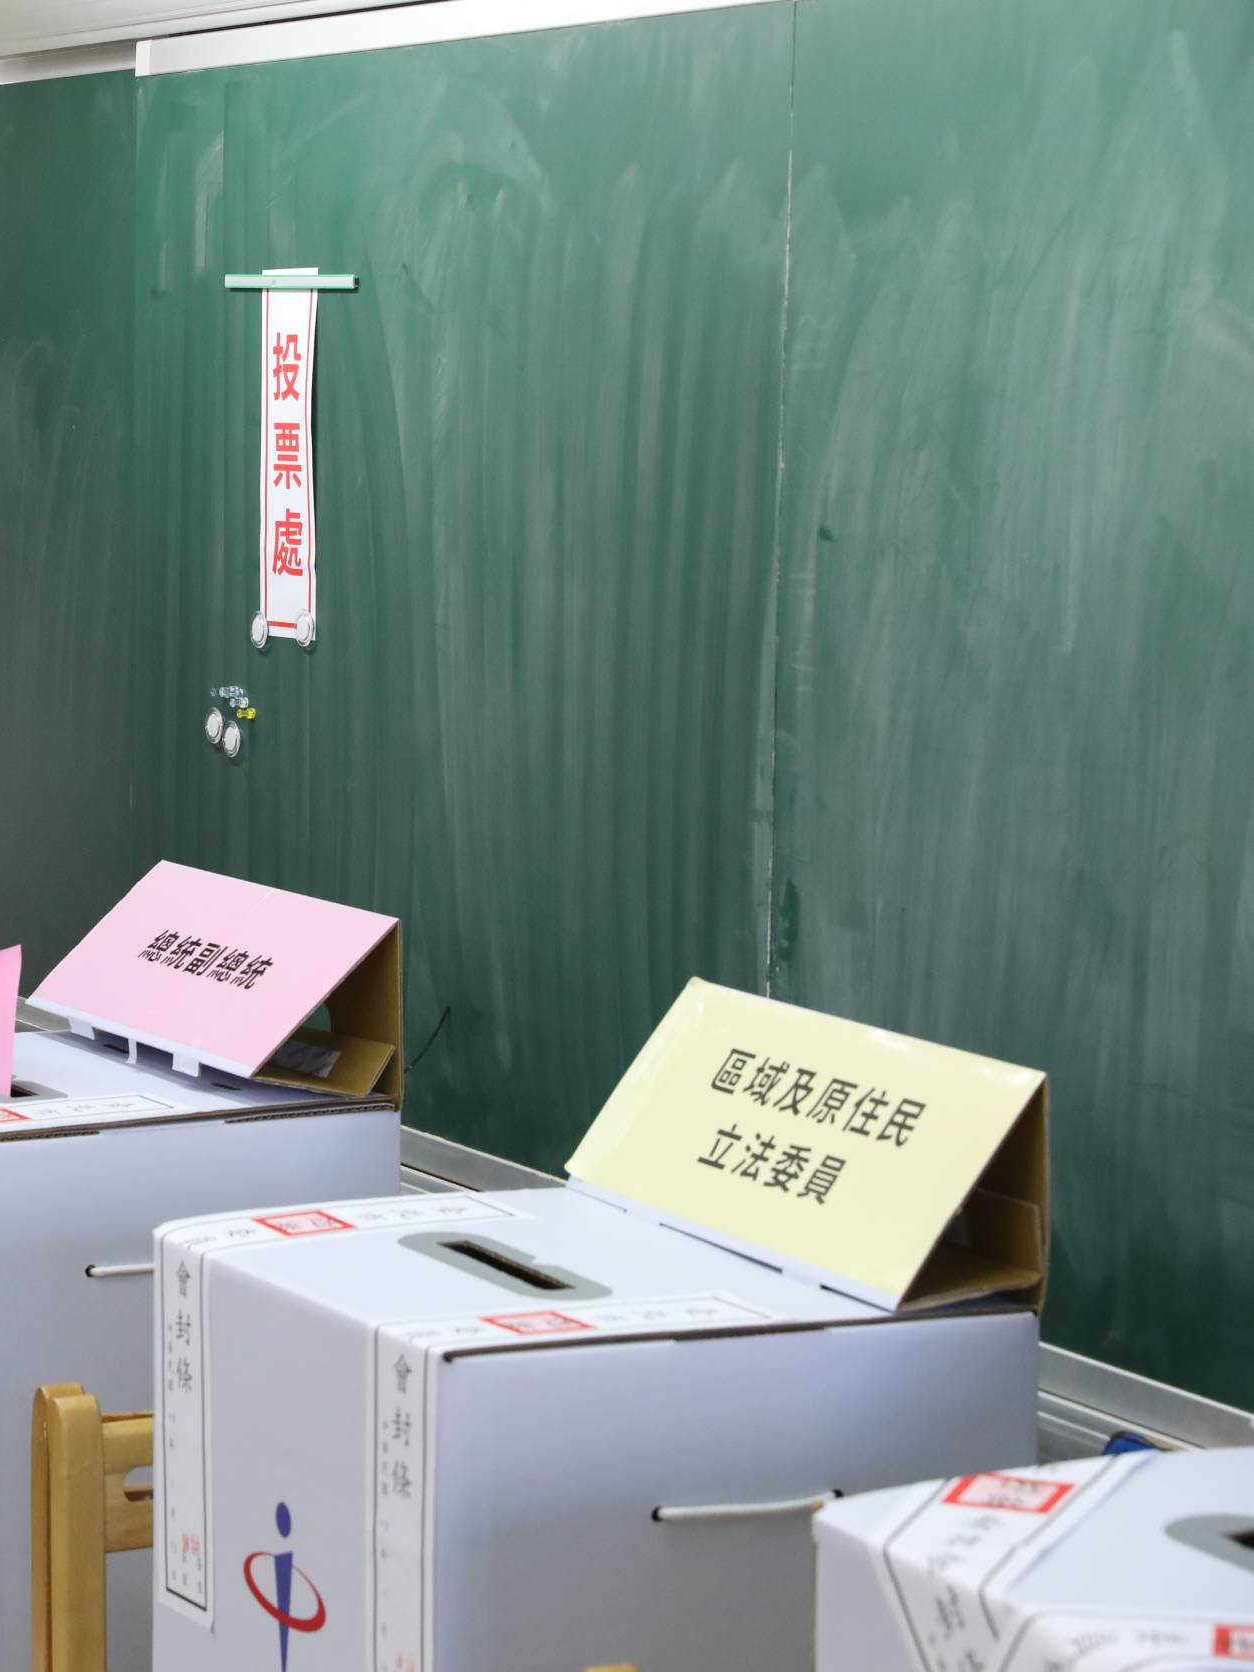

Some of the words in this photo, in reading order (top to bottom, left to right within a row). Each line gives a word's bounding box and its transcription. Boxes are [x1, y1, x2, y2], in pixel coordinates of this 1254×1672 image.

[272, 332, 303, 577] 投票處
[138, 929, 274, 990] 總統副總統
[710, 1048, 926, 1147] 區域及原住民
[697, 1124, 846, 1205] 立法委員
